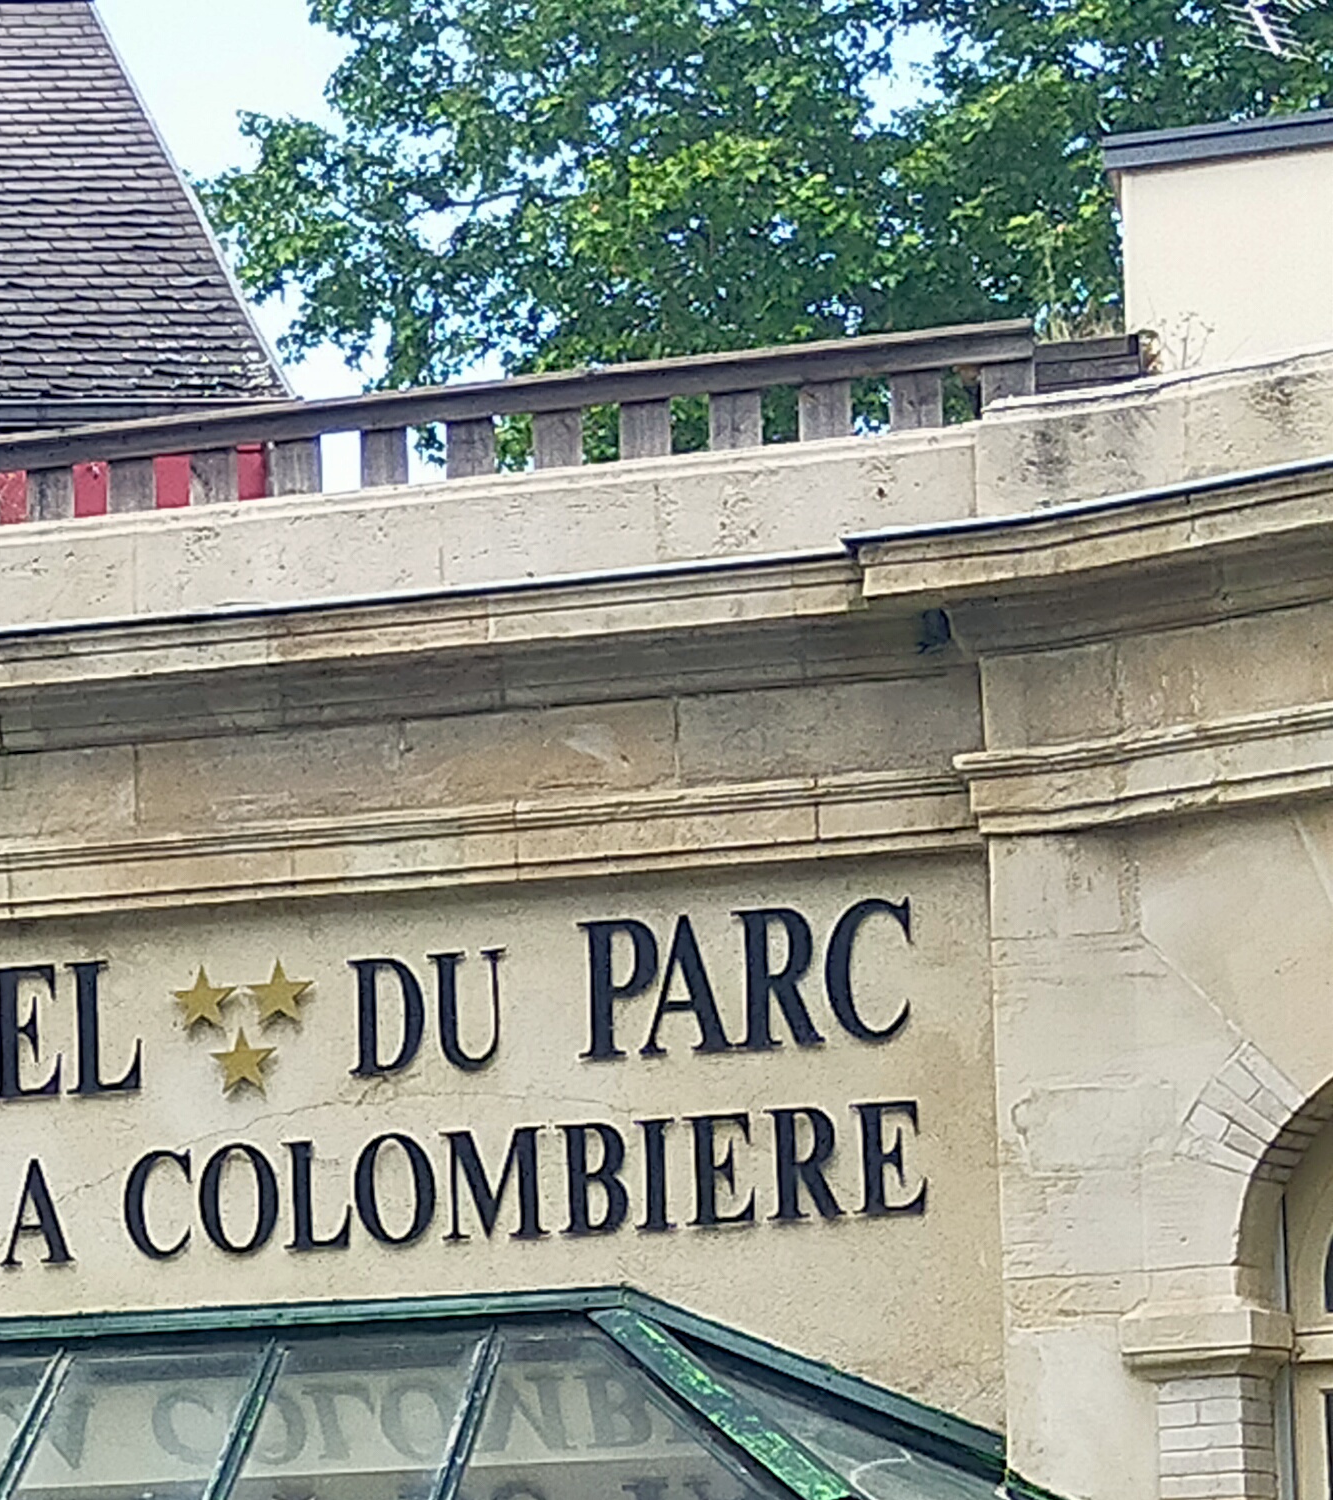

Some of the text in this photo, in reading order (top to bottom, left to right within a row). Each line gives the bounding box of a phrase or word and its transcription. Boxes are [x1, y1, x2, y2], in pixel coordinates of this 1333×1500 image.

[347, 948, 507, 1082] DU
[576, 896, 913, 1063] PARC
[124, 1100, 930, 1261] COLOMBIERE
